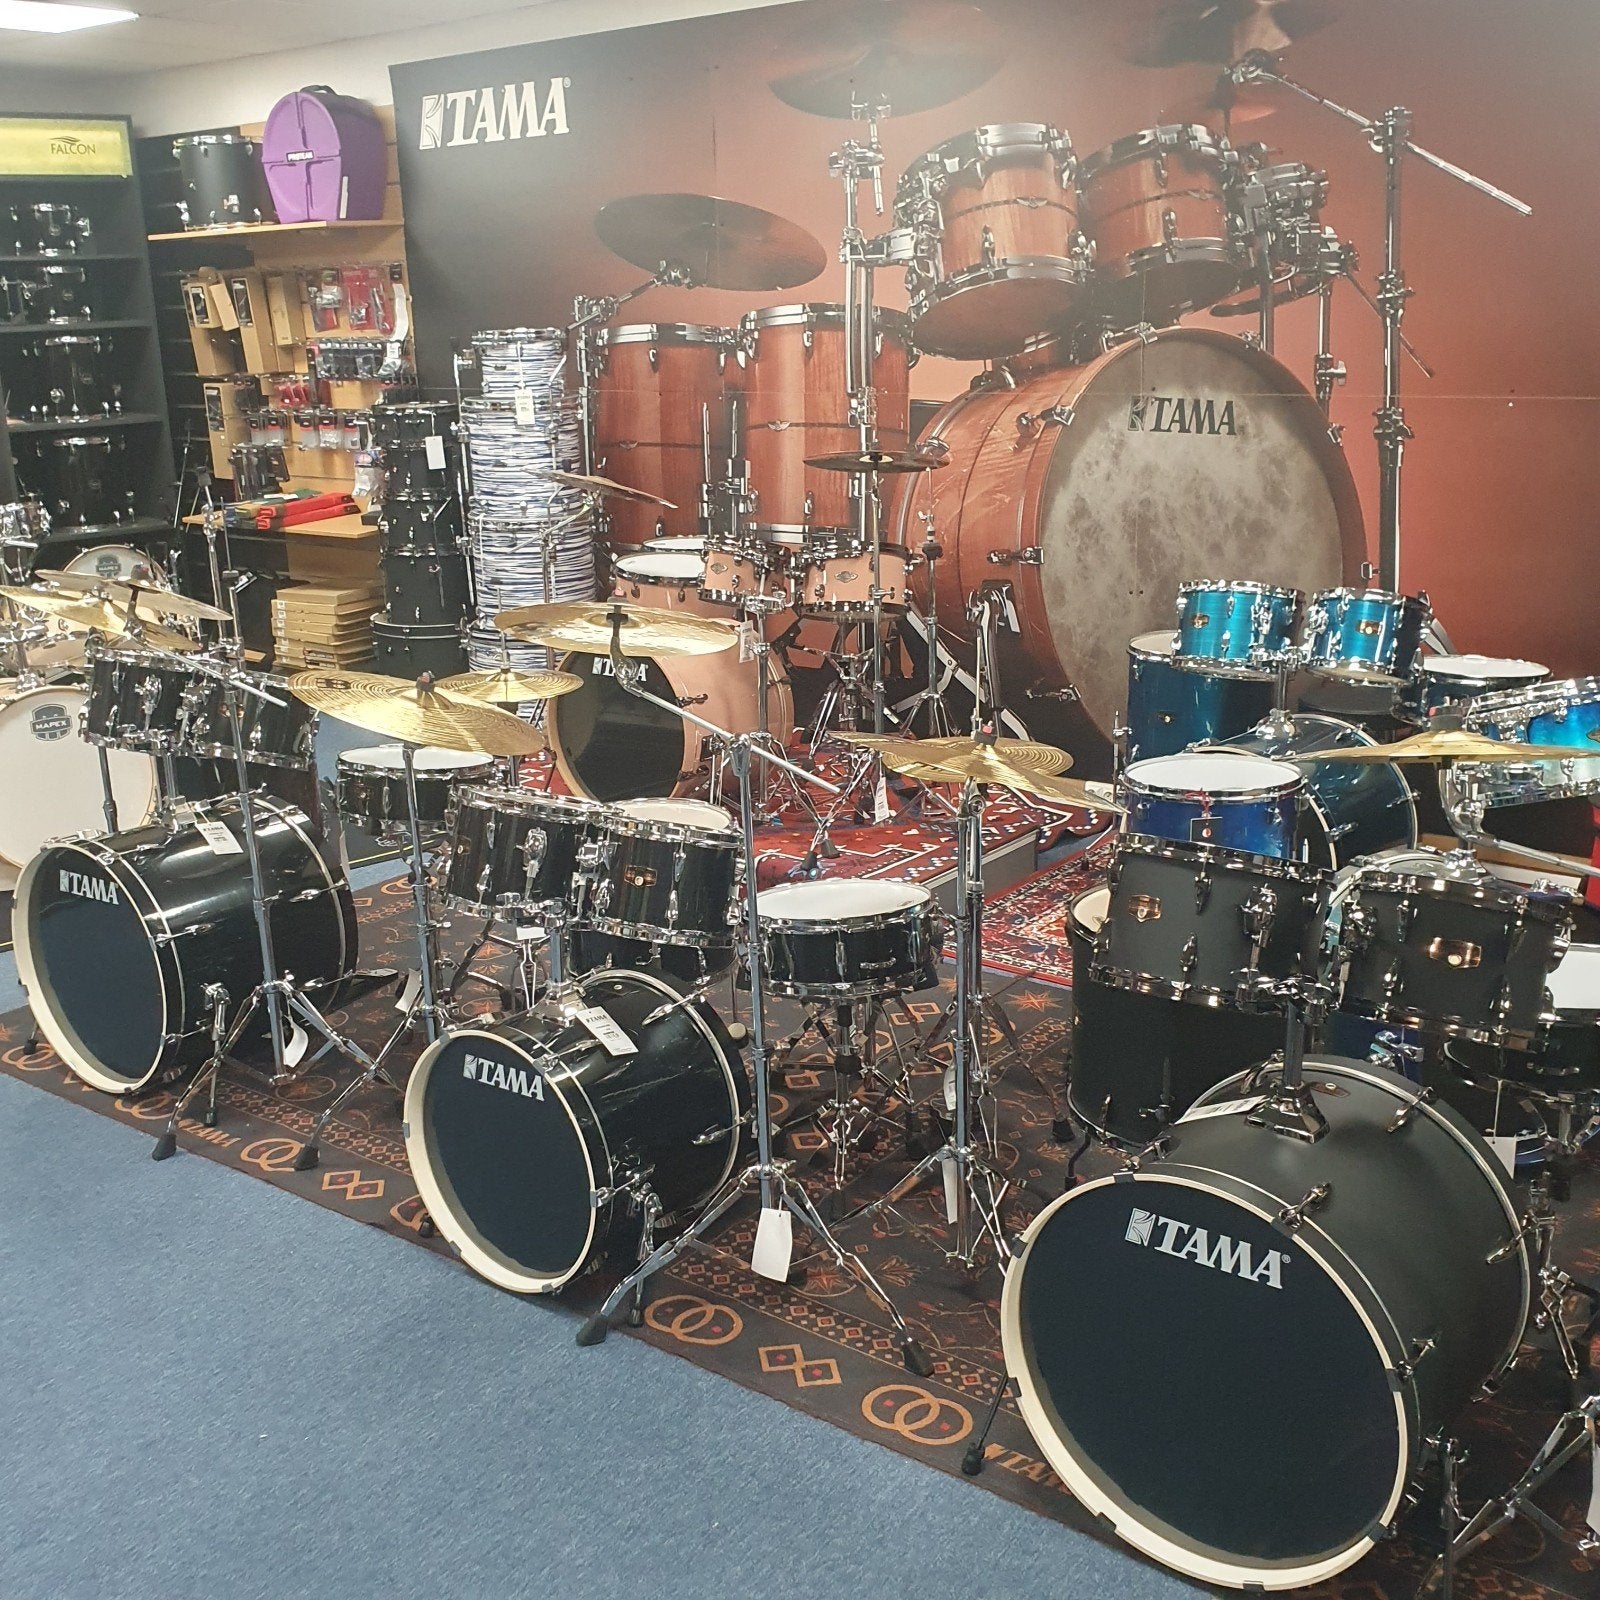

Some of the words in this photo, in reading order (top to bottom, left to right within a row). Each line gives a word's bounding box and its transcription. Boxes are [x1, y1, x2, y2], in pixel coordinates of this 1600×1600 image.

[446, 77, 570, 147] TAMA
[50, 143, 96, 155] FALCON
[1149, 396, 1237, 436] TAMA
[602, 658, 647, 682] TA
[35, 720, 68, 730] MAPEX
[69, 871, 119, 905] TAMA
[478, 1057, 545, 1102] TAMA
[1154, 1216, 1283, 1290] TAMA
